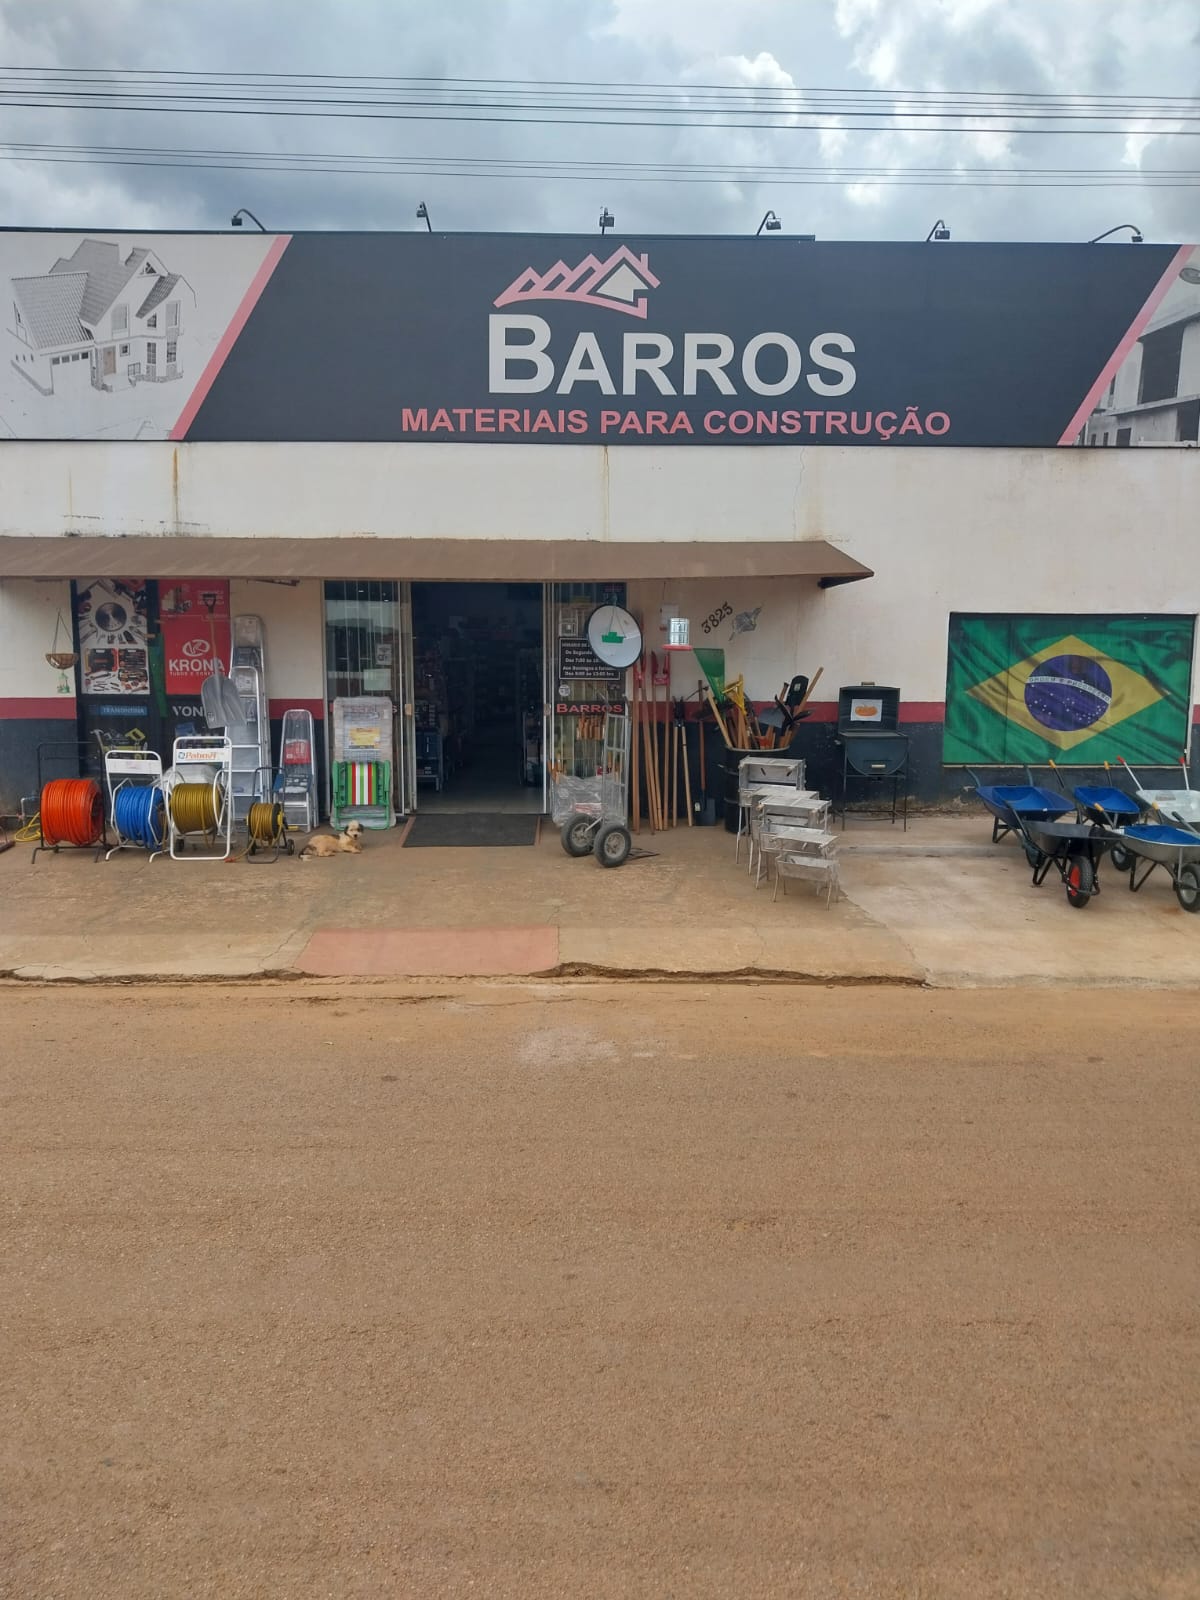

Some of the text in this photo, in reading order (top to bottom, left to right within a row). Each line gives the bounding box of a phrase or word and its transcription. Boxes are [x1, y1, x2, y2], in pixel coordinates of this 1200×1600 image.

[488, 313, 857, 397] BARROS
[401, 405, 951, 441] MATERIAIS PARA CONSTRUÇÃO
[701, 600, 733, 634] 3825
[556, 703, 623, 713] BARROS
